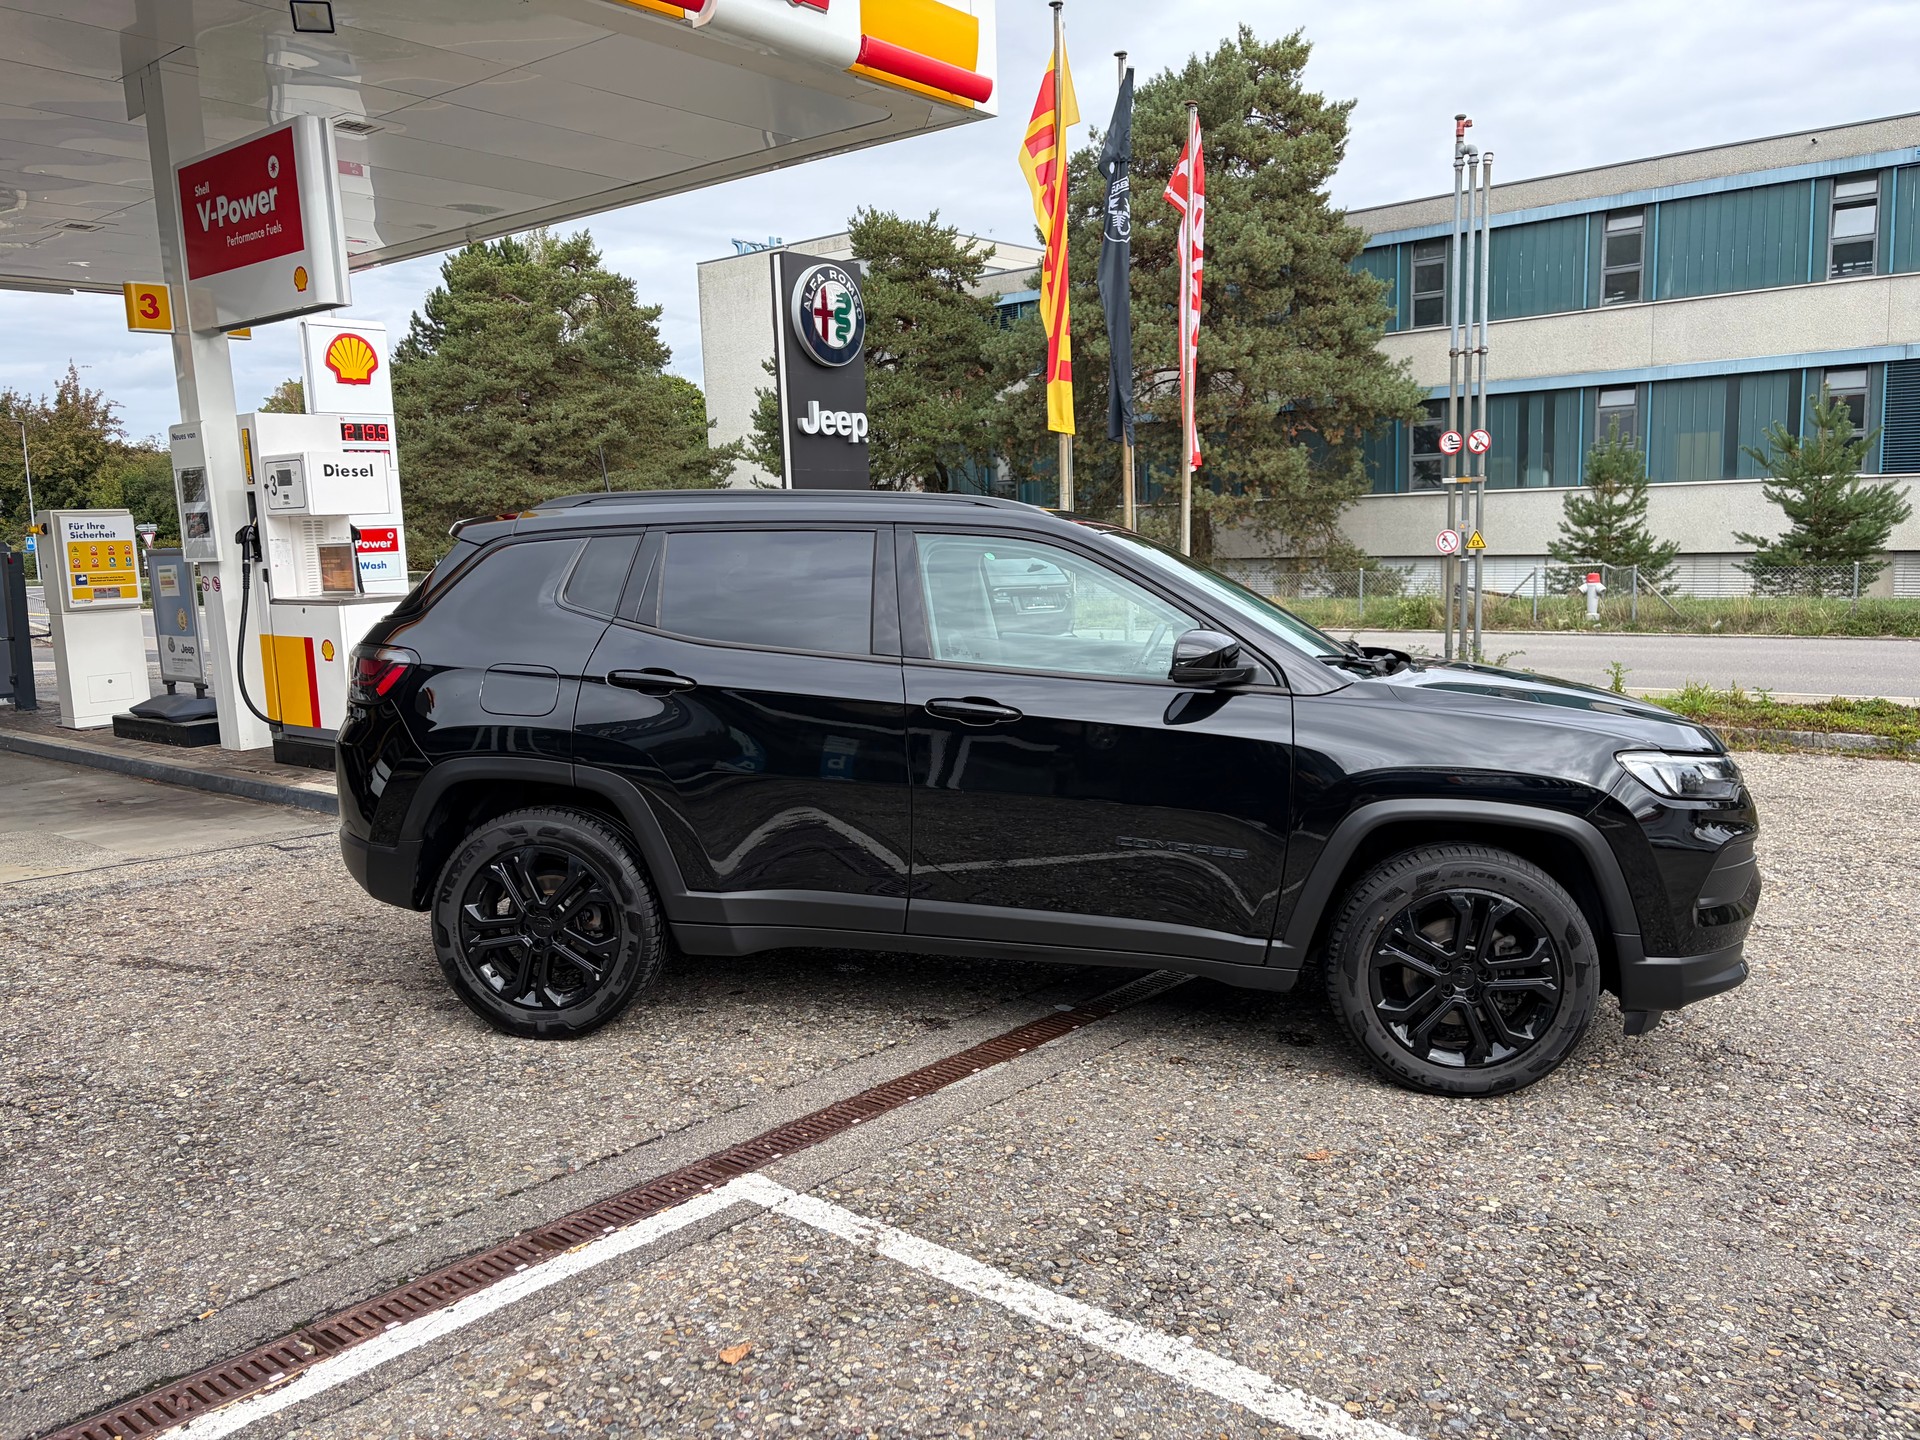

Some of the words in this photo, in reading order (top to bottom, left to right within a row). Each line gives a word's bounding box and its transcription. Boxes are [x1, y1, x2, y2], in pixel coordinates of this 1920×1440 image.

[194, 181, 210, 197] Shell
[196, 186, 278, 232] V-Power
[226, 228, 265, 247] Performance
[265, 220, 282, 236] Fuels
[803, 273, 826, 312] ALFA
[829, 269, 863, 320] ROMEO
[139, 293, 160, 319] 3
[797, 400, 868, 443] Jeep
[172, 432, 187, 441] Neues
[323, 463, 374, 477] Diesel
[270, 474, 278, 497] 3
[68, 522, 85, 531] Für
[86, 522, 106, 530] Ihre
[69, 531, 116, 539] Sicherheit
[360, 560, 387, 570] Wash
[180, 643, 195, 656] Jeep
[440, 838, 488, 904] NEXEN
